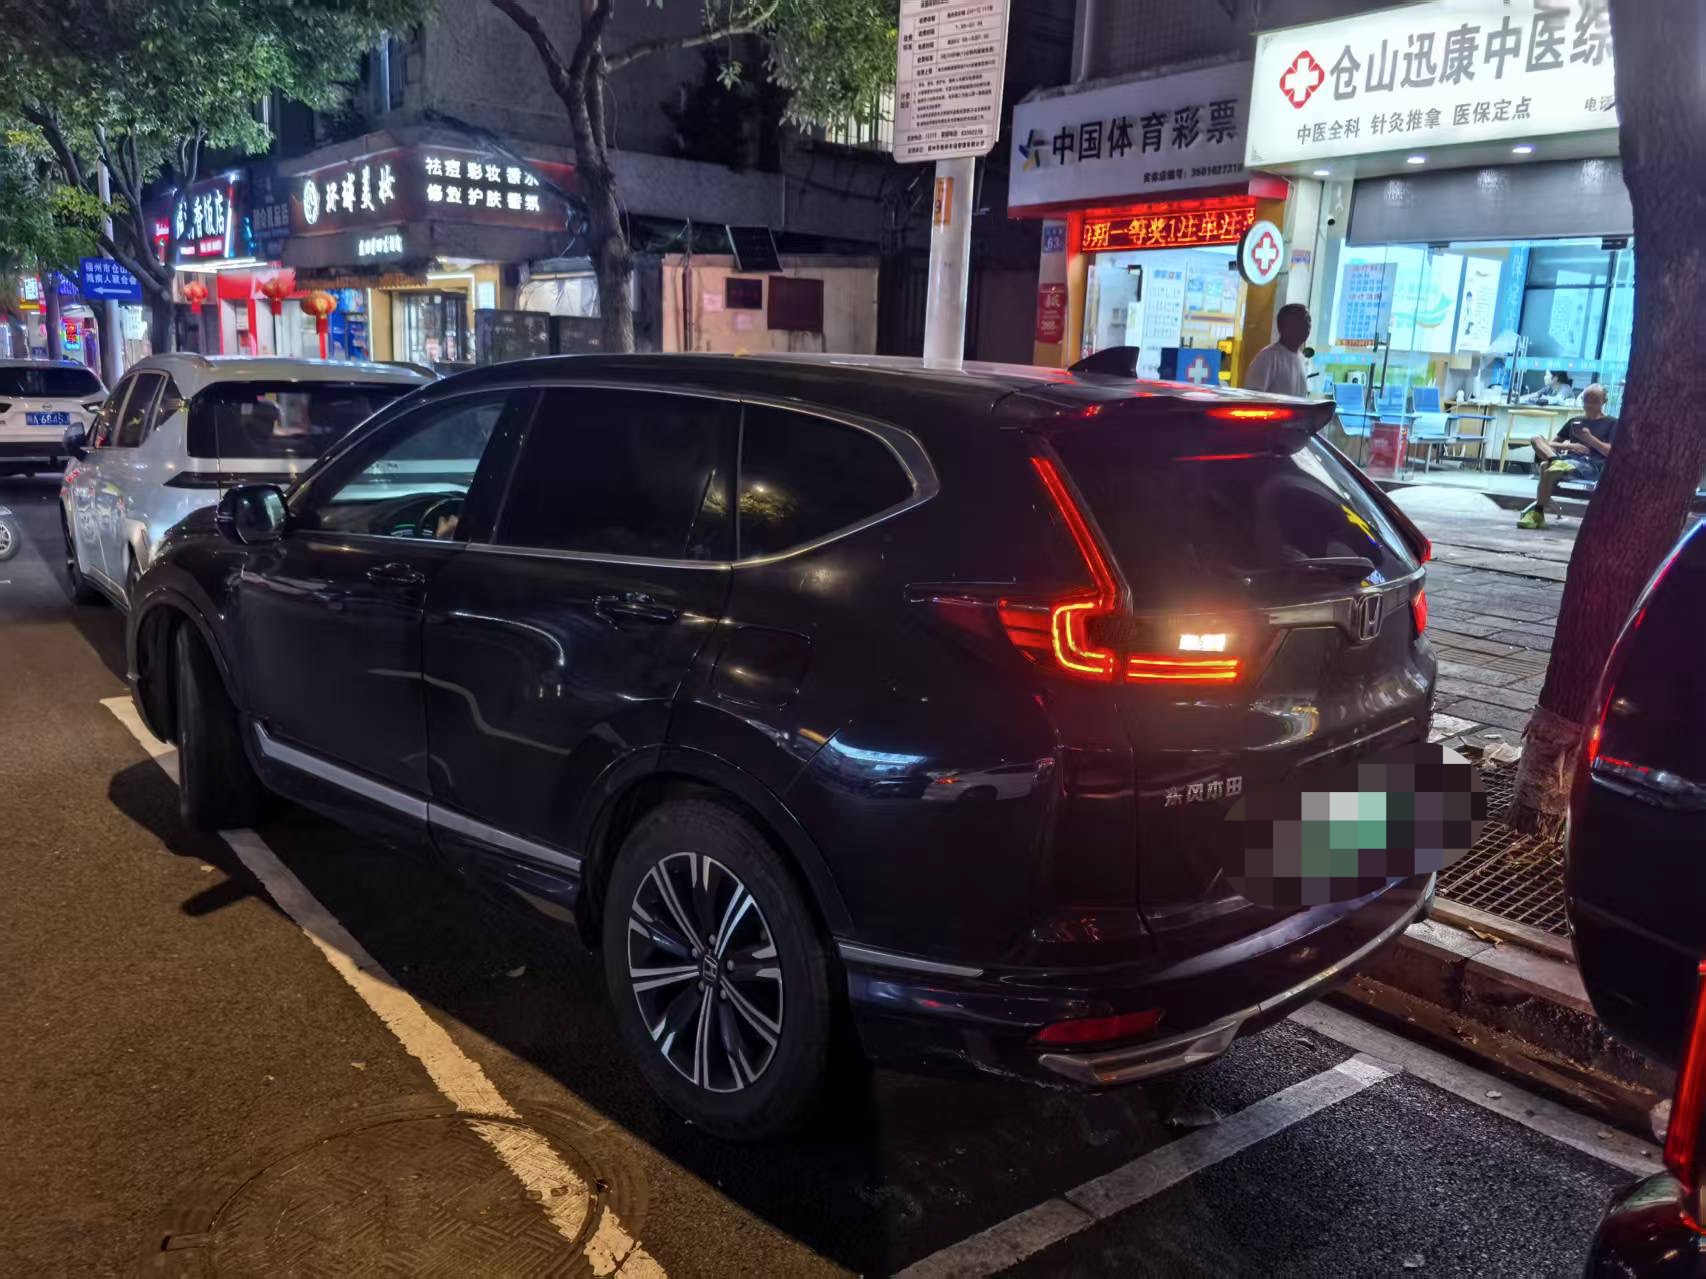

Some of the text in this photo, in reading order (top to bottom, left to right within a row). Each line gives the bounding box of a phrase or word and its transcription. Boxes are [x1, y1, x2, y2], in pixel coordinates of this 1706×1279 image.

[1052, 99, 1238, 166] 中国体育彩票
[1296, 116, 1361, 145] 中医全科
[1370, 106, 1441, 137] 针灸推拿
[1453, 97, 1532, 127] 医保定点
[85, 262, 132, 274] 福州市仓山
[1164, 775, 1242, 807] 东风本田
